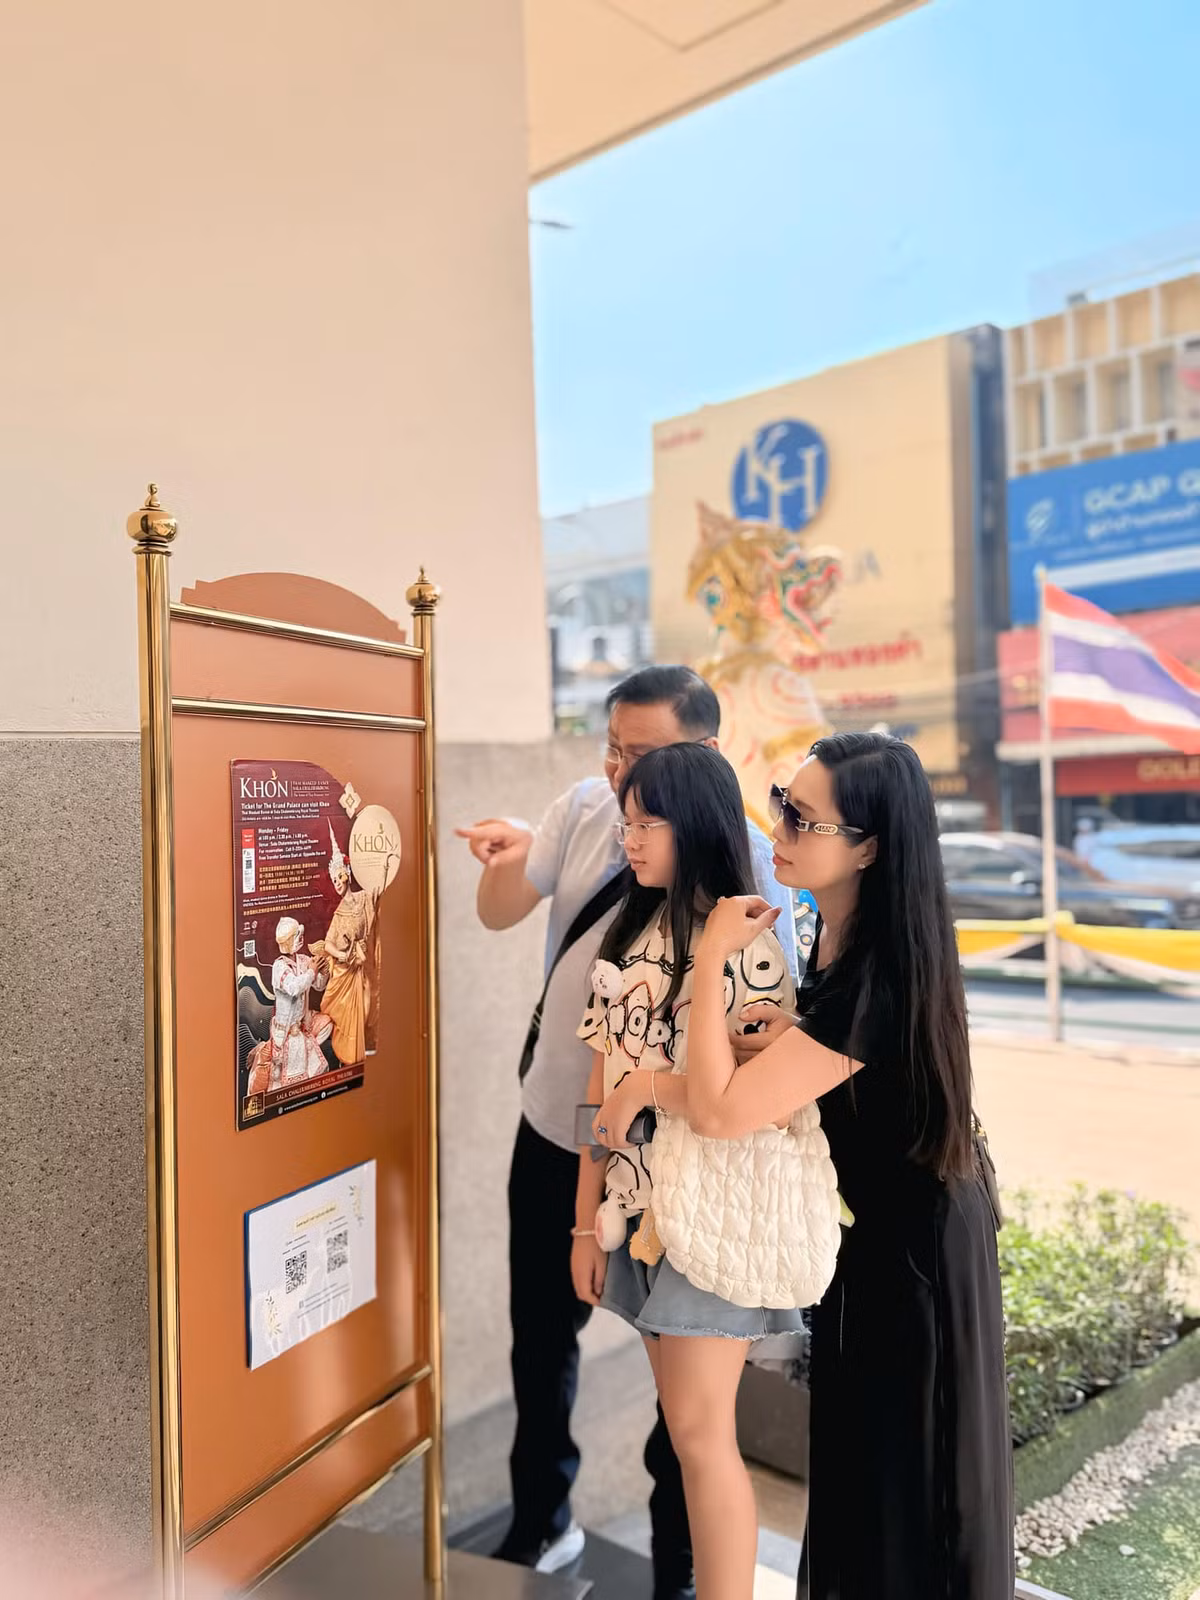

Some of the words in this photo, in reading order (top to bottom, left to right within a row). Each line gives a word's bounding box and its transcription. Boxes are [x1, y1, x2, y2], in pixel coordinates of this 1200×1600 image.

[240, 777, 288, 798] KHON
[241, 802, 256, 810] Ticket
[276, 826, 288, 834] Friday
